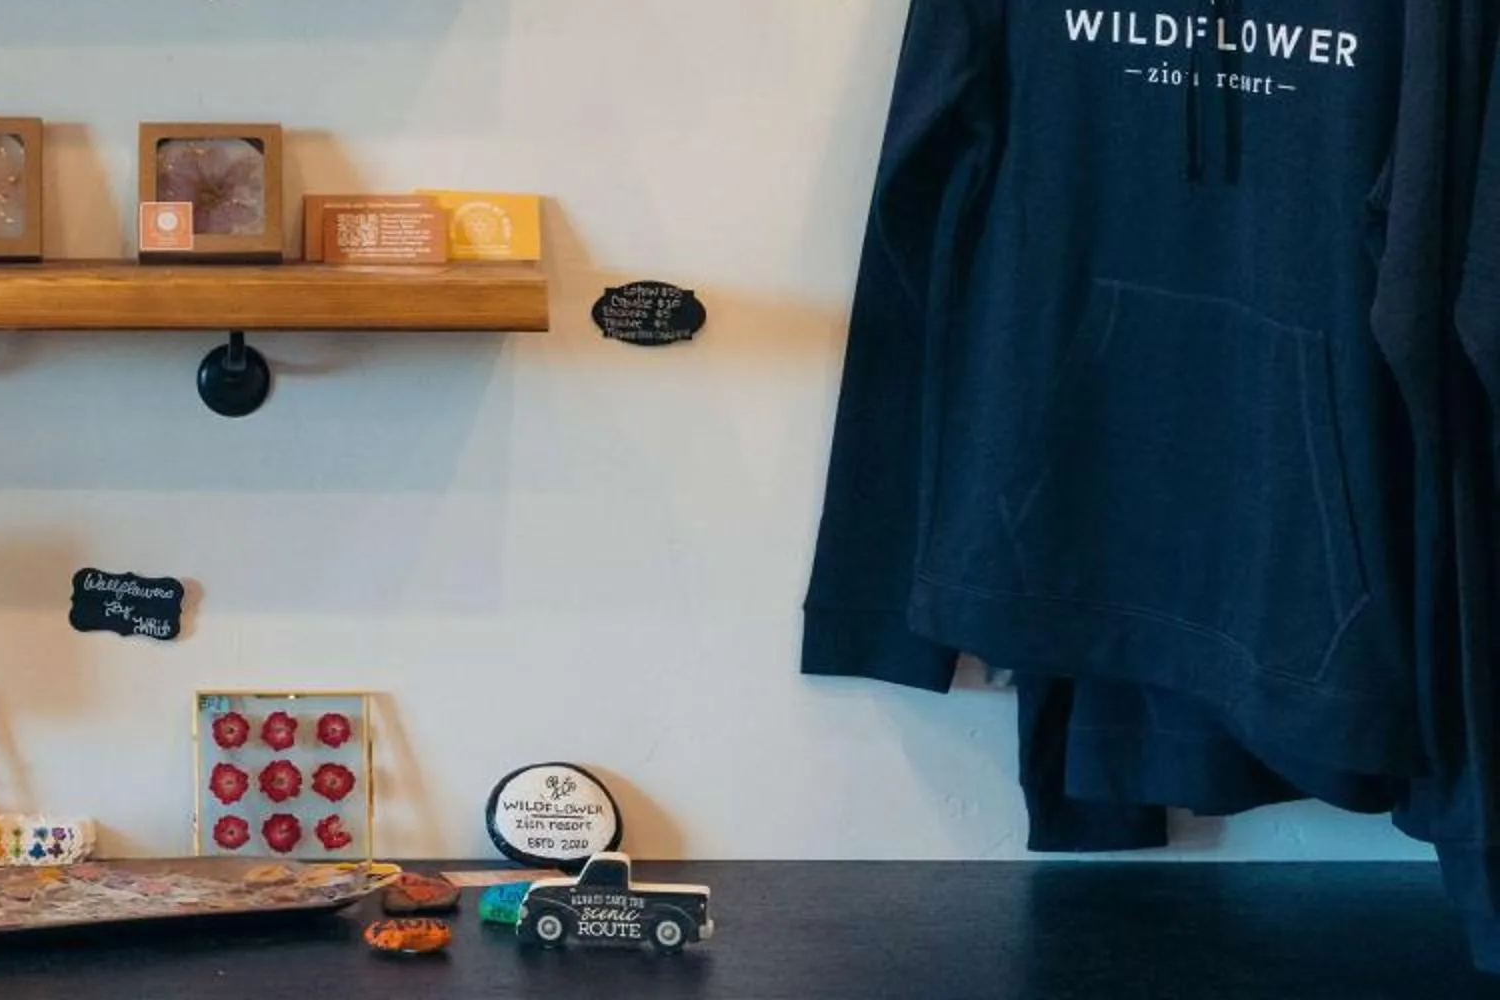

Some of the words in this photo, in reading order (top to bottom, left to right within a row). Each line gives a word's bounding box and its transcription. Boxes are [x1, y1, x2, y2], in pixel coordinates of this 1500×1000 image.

[1064, 8, 1359, 68] WILDFLOWER
[503, 801, 603, 815] WILDFLOWER
[577, 921, 641, 938] ROUTE
